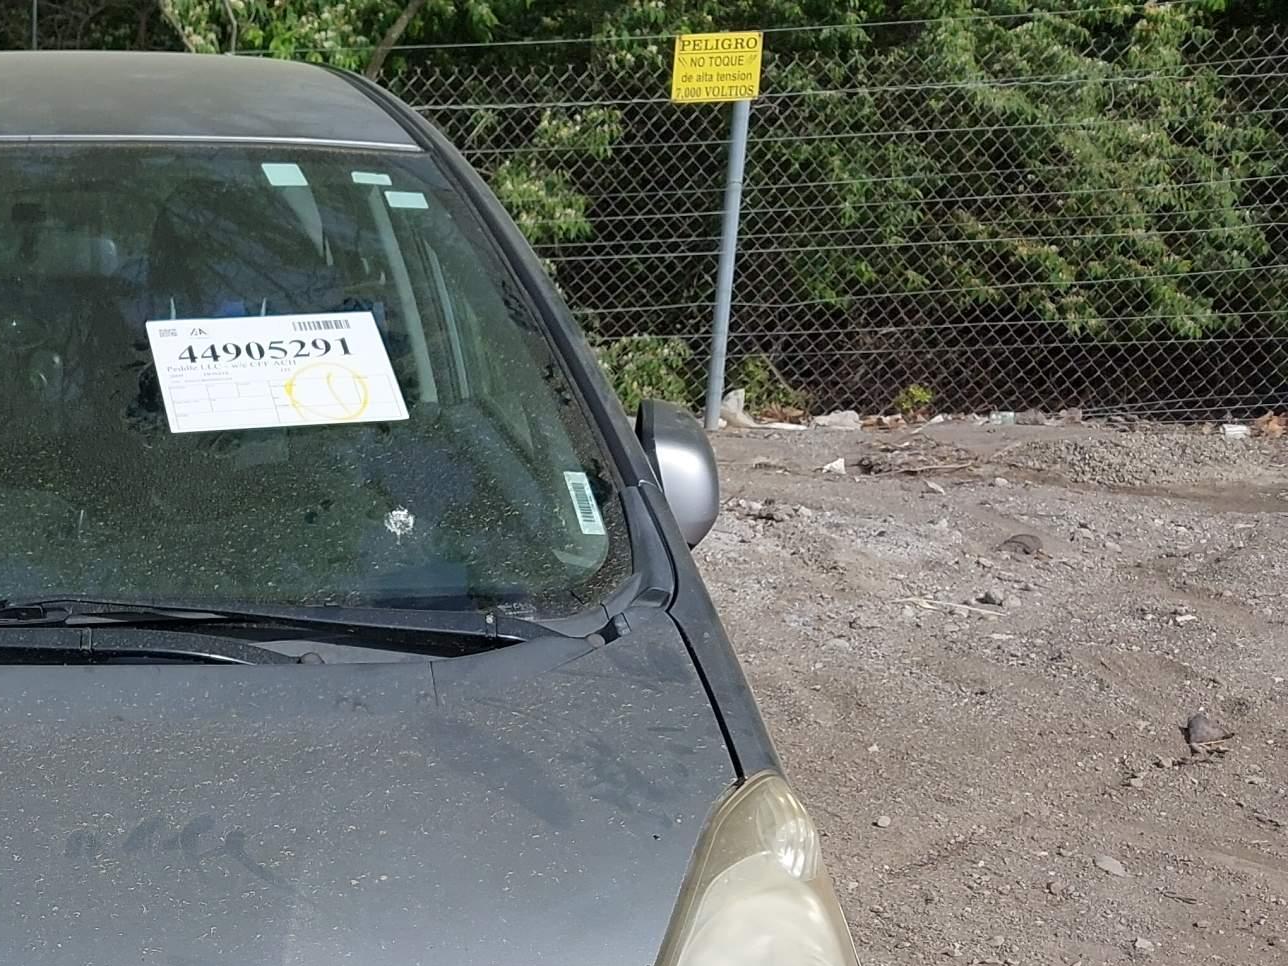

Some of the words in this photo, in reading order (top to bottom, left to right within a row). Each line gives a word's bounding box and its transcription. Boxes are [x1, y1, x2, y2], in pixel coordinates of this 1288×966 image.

[680, 36, 758, 52] PELIGRO
[690, 56, 705, 68] NO
[709, 55, 745, 68] TOQUE
[681, 72, 693, 83] de
[696, 71, 713, 82] alta
[716, 70, 753, 82] tension
[705, 85, 754, 98] VOLTIOS
[178, 337, 353, 363] 44905291
